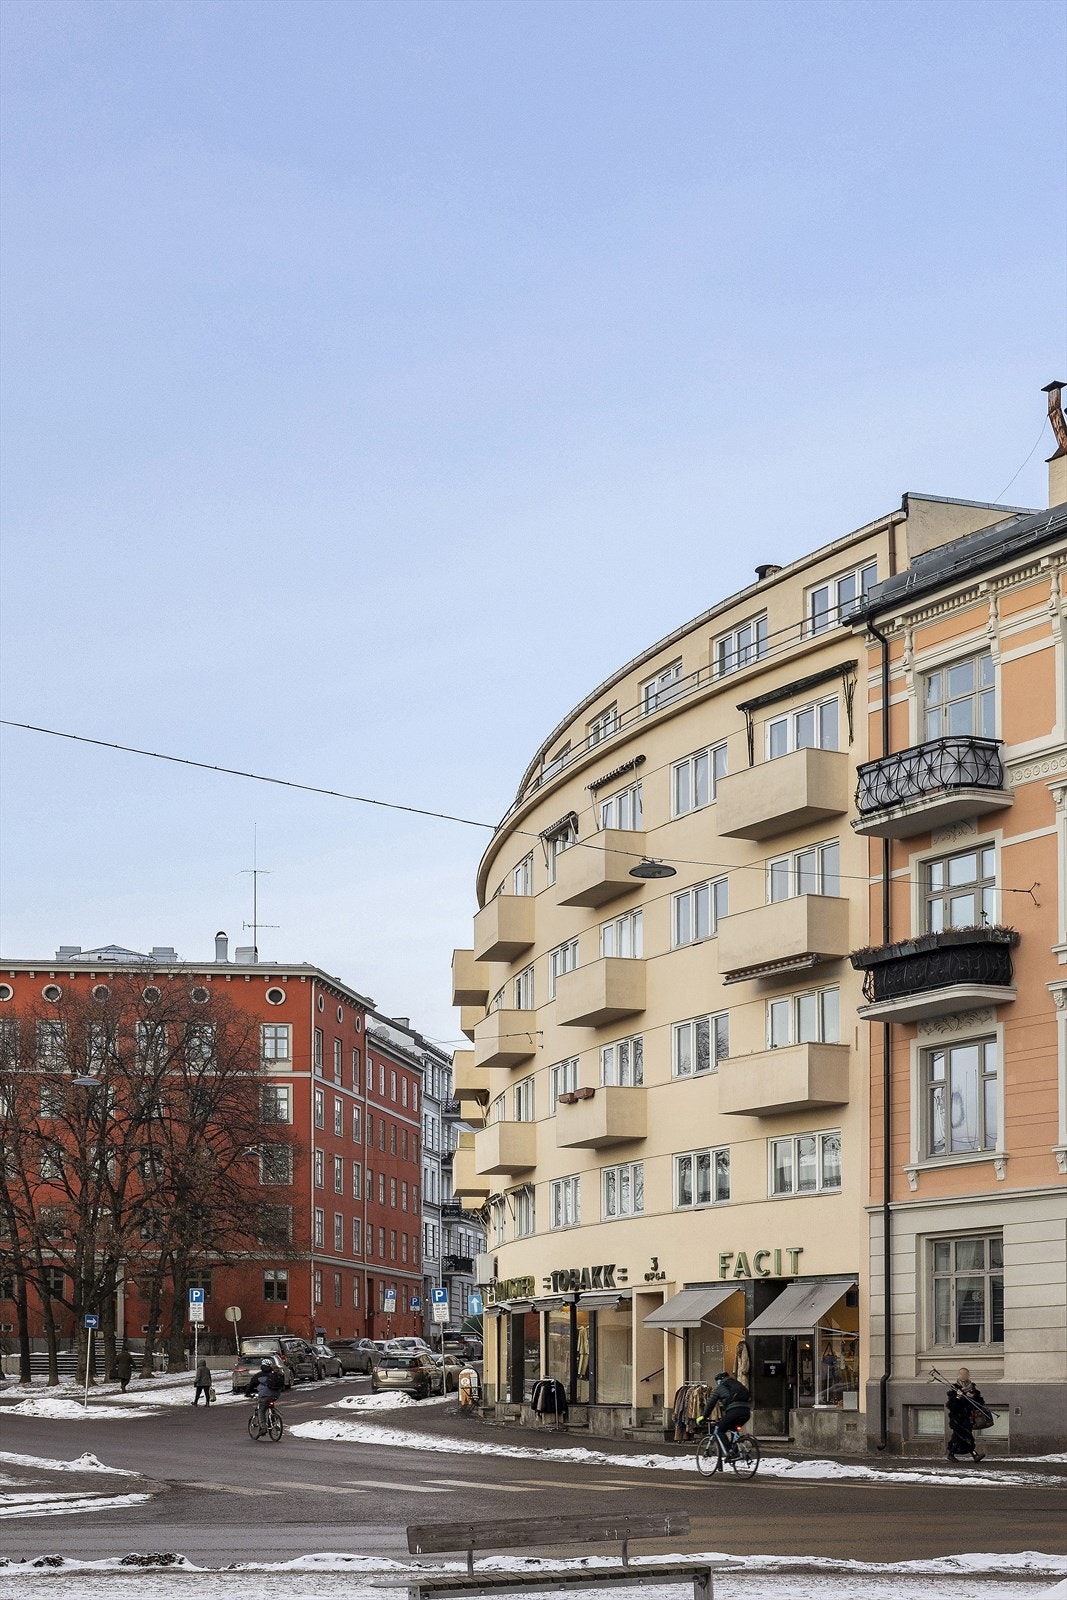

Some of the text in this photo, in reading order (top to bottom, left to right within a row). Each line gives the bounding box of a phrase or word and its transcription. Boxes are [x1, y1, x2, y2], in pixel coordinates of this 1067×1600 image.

[719, 1248, 803, 1278] FACIT
[193, 1290, 201, 1302] P
[435, 1290, 444, 1302] P
